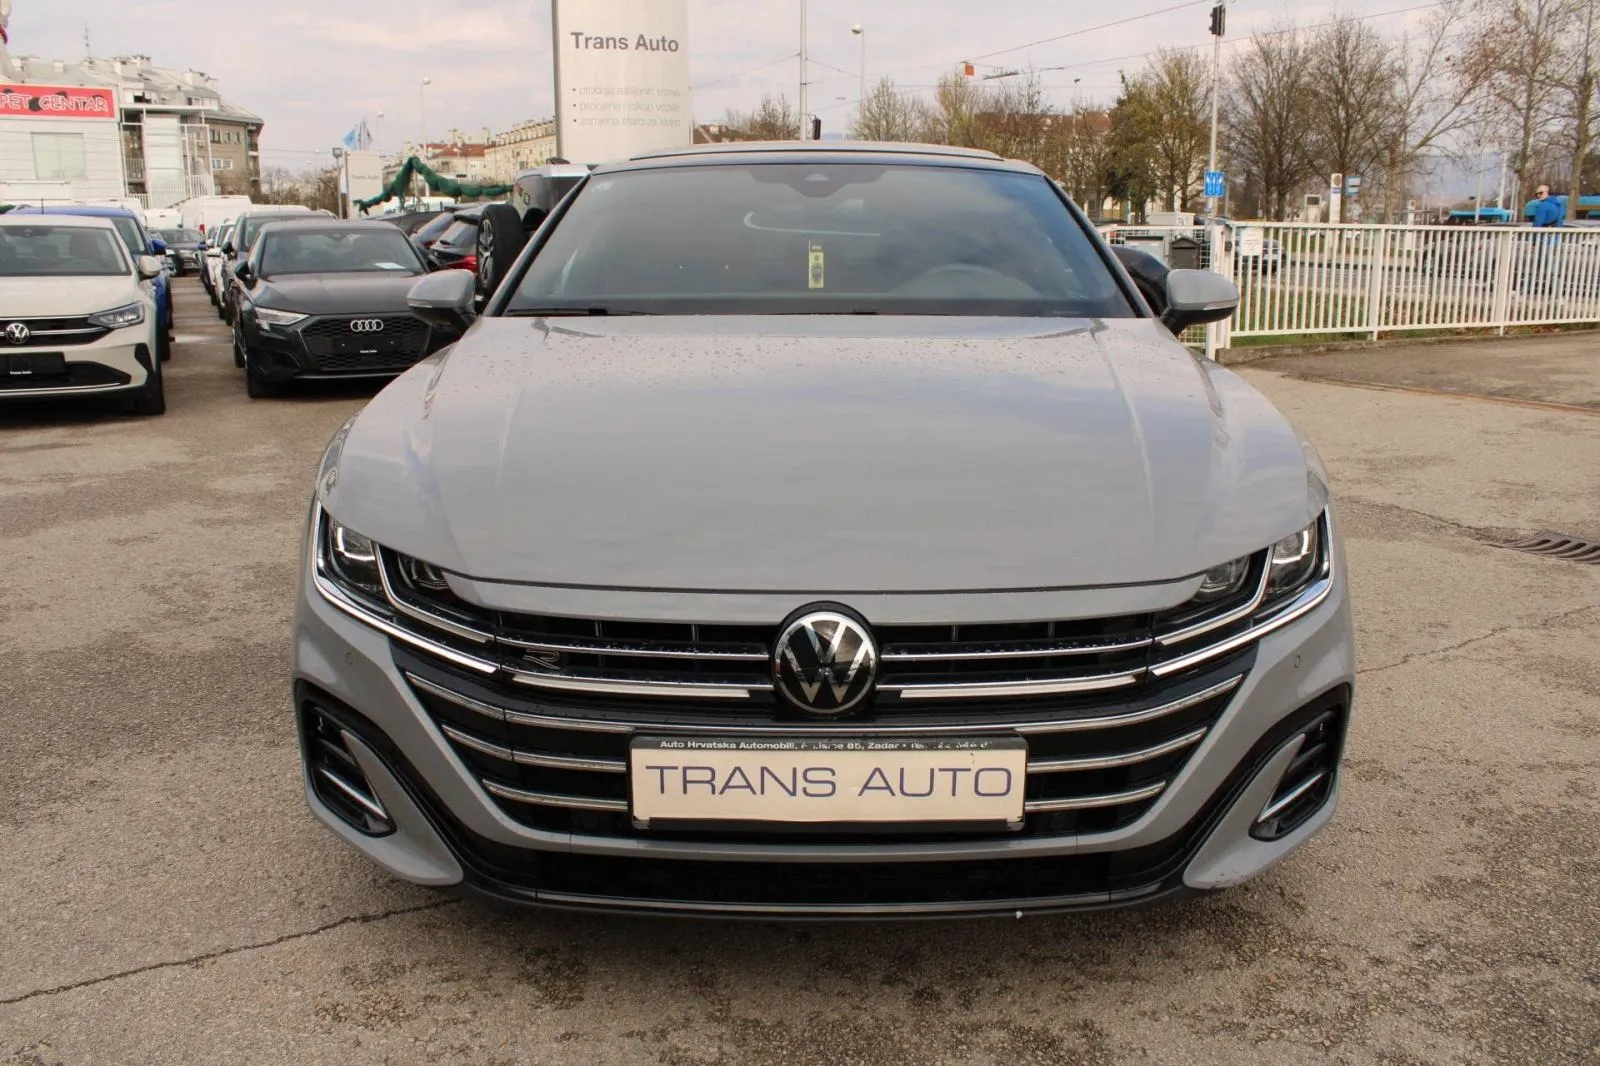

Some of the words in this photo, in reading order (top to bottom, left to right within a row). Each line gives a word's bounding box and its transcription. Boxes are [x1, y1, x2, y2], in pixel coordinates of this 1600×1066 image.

[570, 32, 629, 50] Trans
[635, 34, 679, 52] Auto
[39, 95, 108, 112] CENTAR
[660, 740, 685, 749] Auto
[687, 740, 737, 749] Hrvatska
[867, 741, 900, 749] Zadar
[645, 765, 837, 798] TRANS
[857, 766, 1012, 798] AUTO
